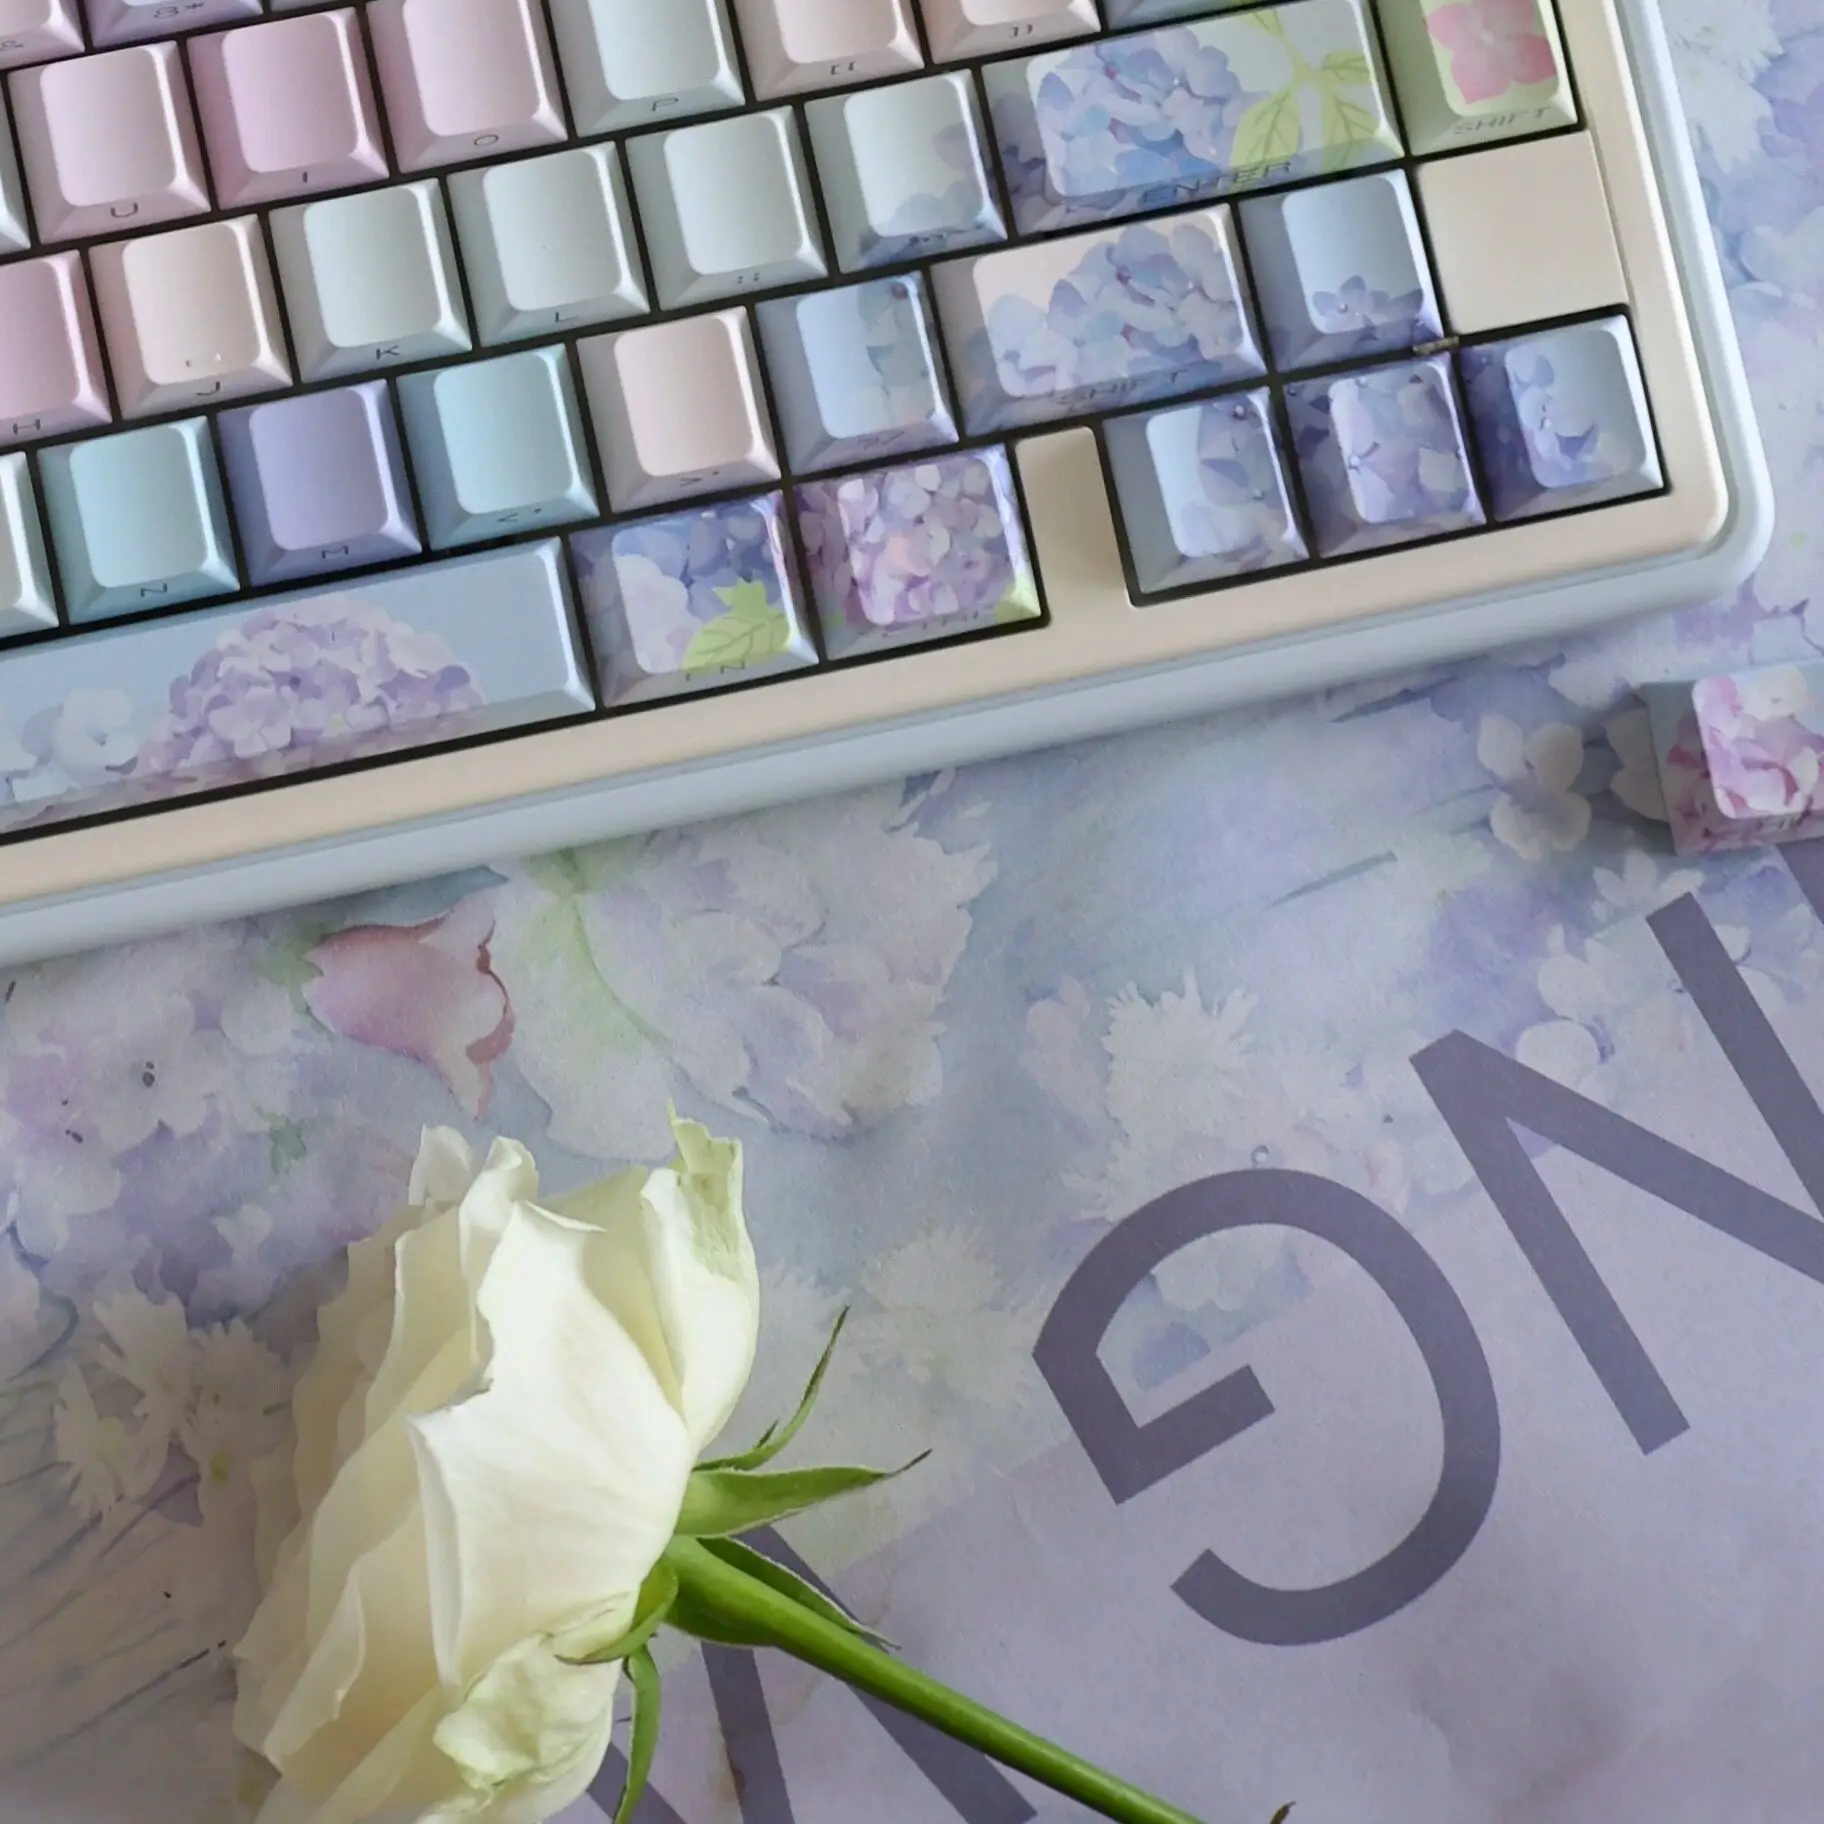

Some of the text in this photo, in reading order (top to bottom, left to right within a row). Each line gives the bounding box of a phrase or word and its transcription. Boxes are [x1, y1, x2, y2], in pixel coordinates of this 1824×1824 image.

[649, 95, 681, 112] P
[110, 202, 142, 221] U
[552, 307, 578, 324] L
[375, 344, 400, 361] K
[195, 380, 222, 398] J
[12, 417, 42, 435] H
[139, 582, 168, 599] N
